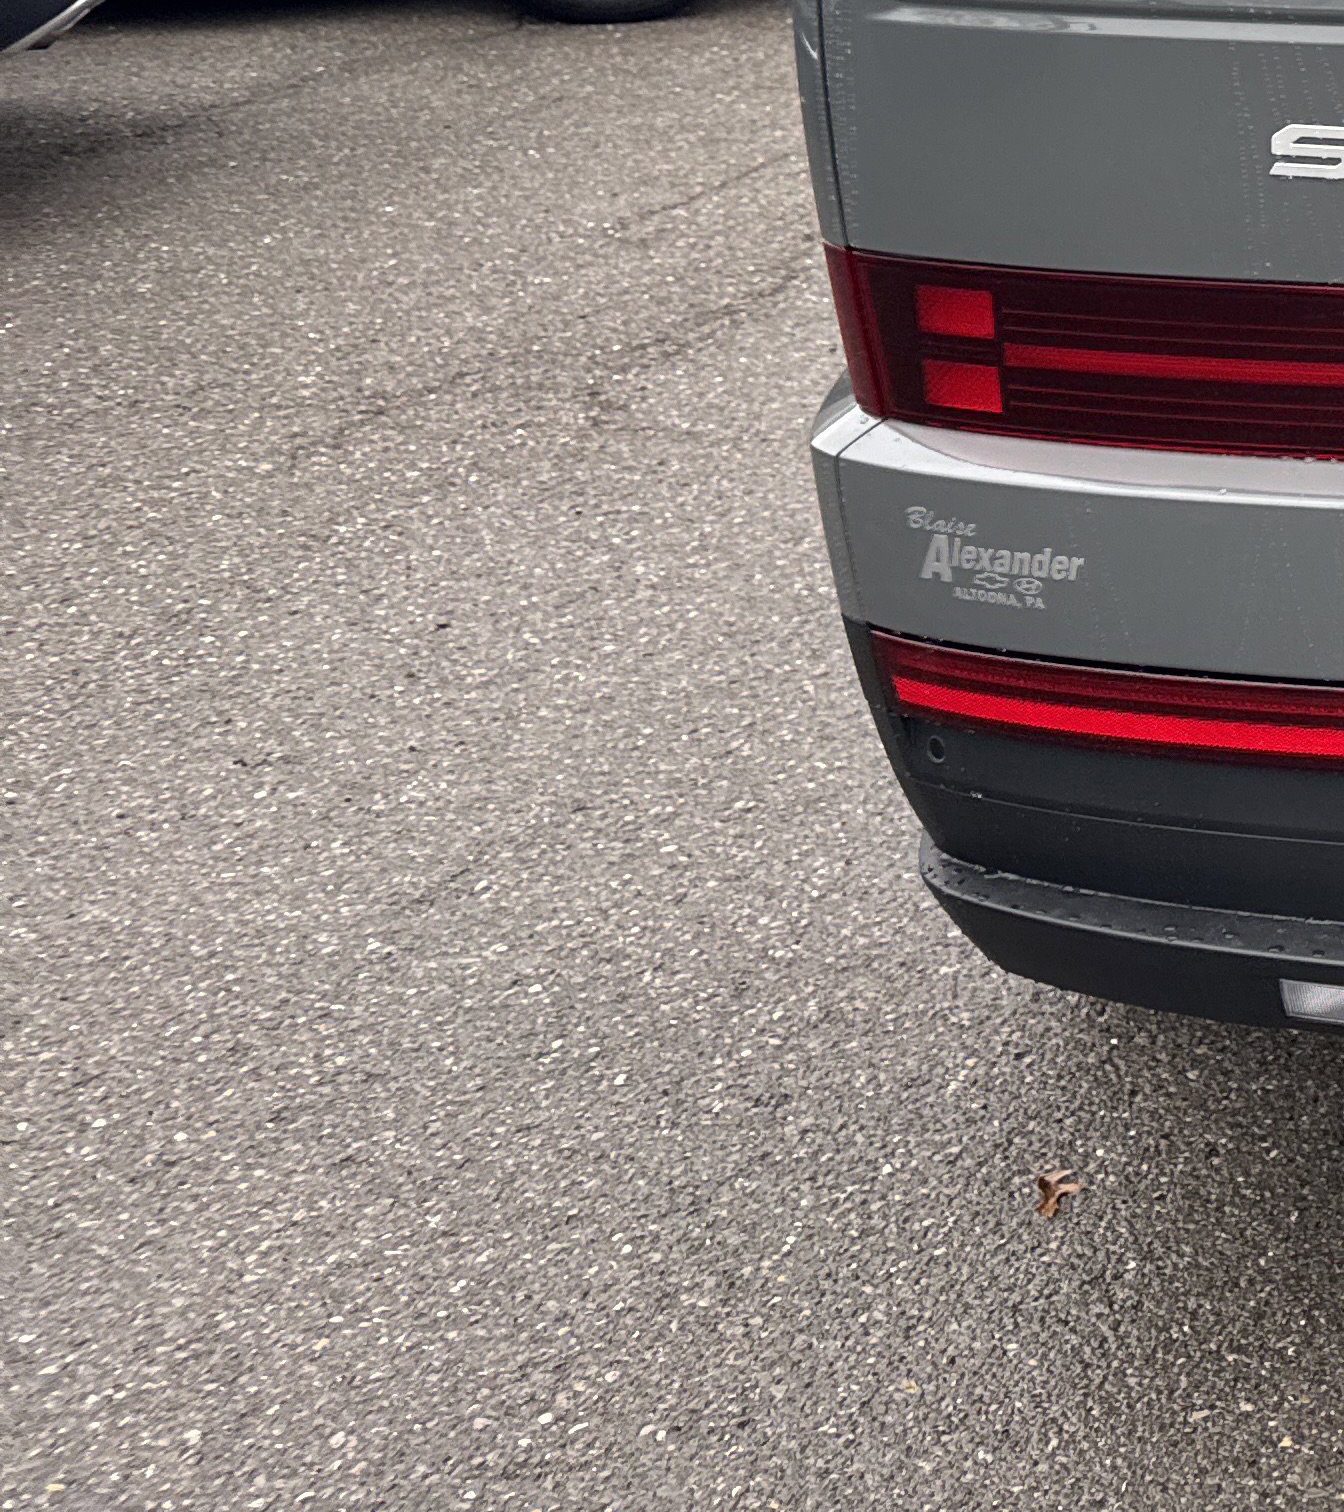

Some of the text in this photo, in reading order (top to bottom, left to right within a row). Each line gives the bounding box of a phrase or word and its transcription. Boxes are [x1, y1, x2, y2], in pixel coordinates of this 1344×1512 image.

[904, 506, 978, 537] Blaise
[920, 534, 1086, 583] Alexander
[1024, 596, 1047, 611] PA
